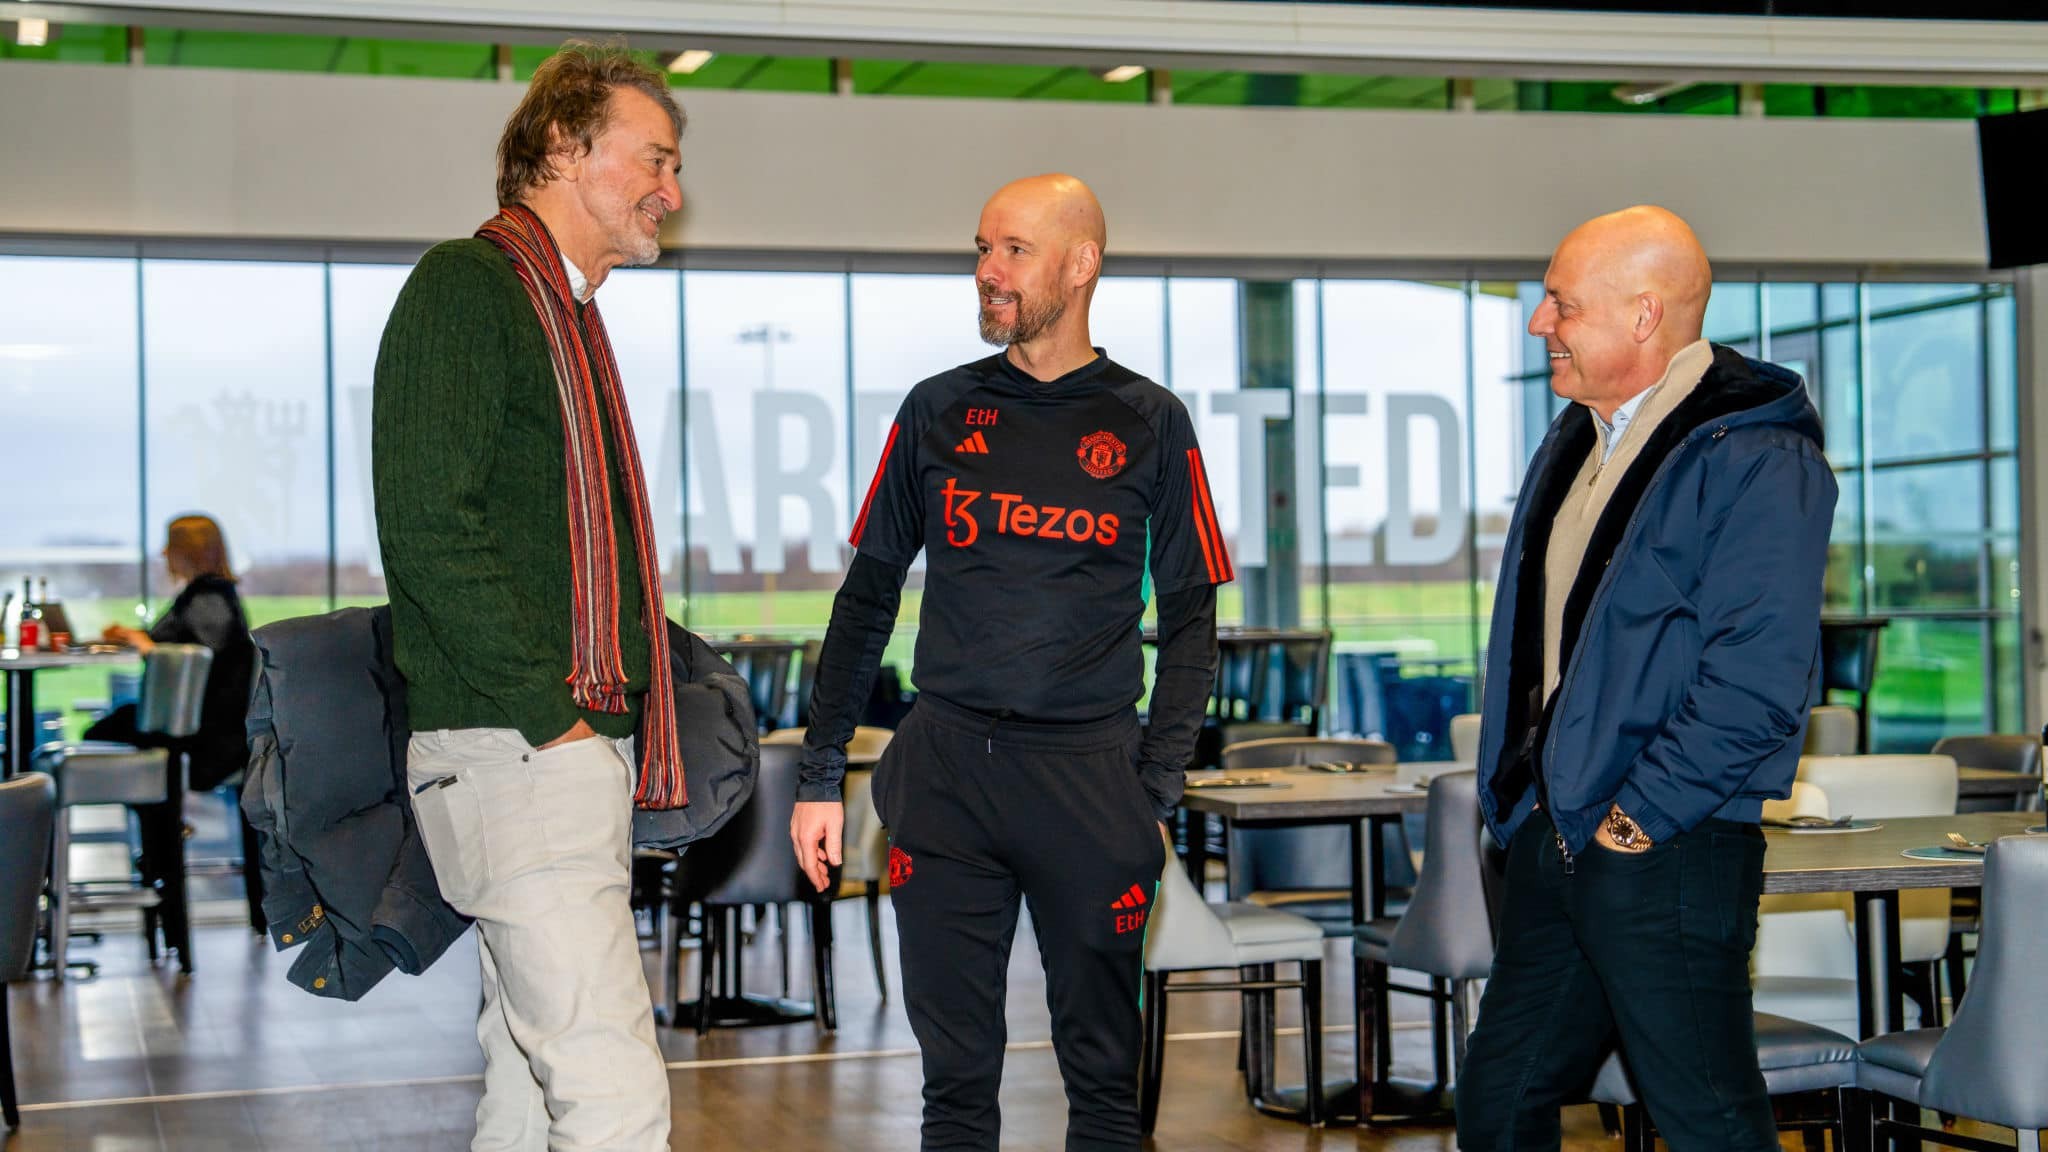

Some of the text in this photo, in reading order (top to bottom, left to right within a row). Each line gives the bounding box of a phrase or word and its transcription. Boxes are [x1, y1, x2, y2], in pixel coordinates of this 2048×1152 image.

[965, 408, 999, 426] EtH
[1177, 390, 1464, 566] TED
[990, 492, 1121, 546] Tezos
[1115, 910, 1146, 935] EtH
